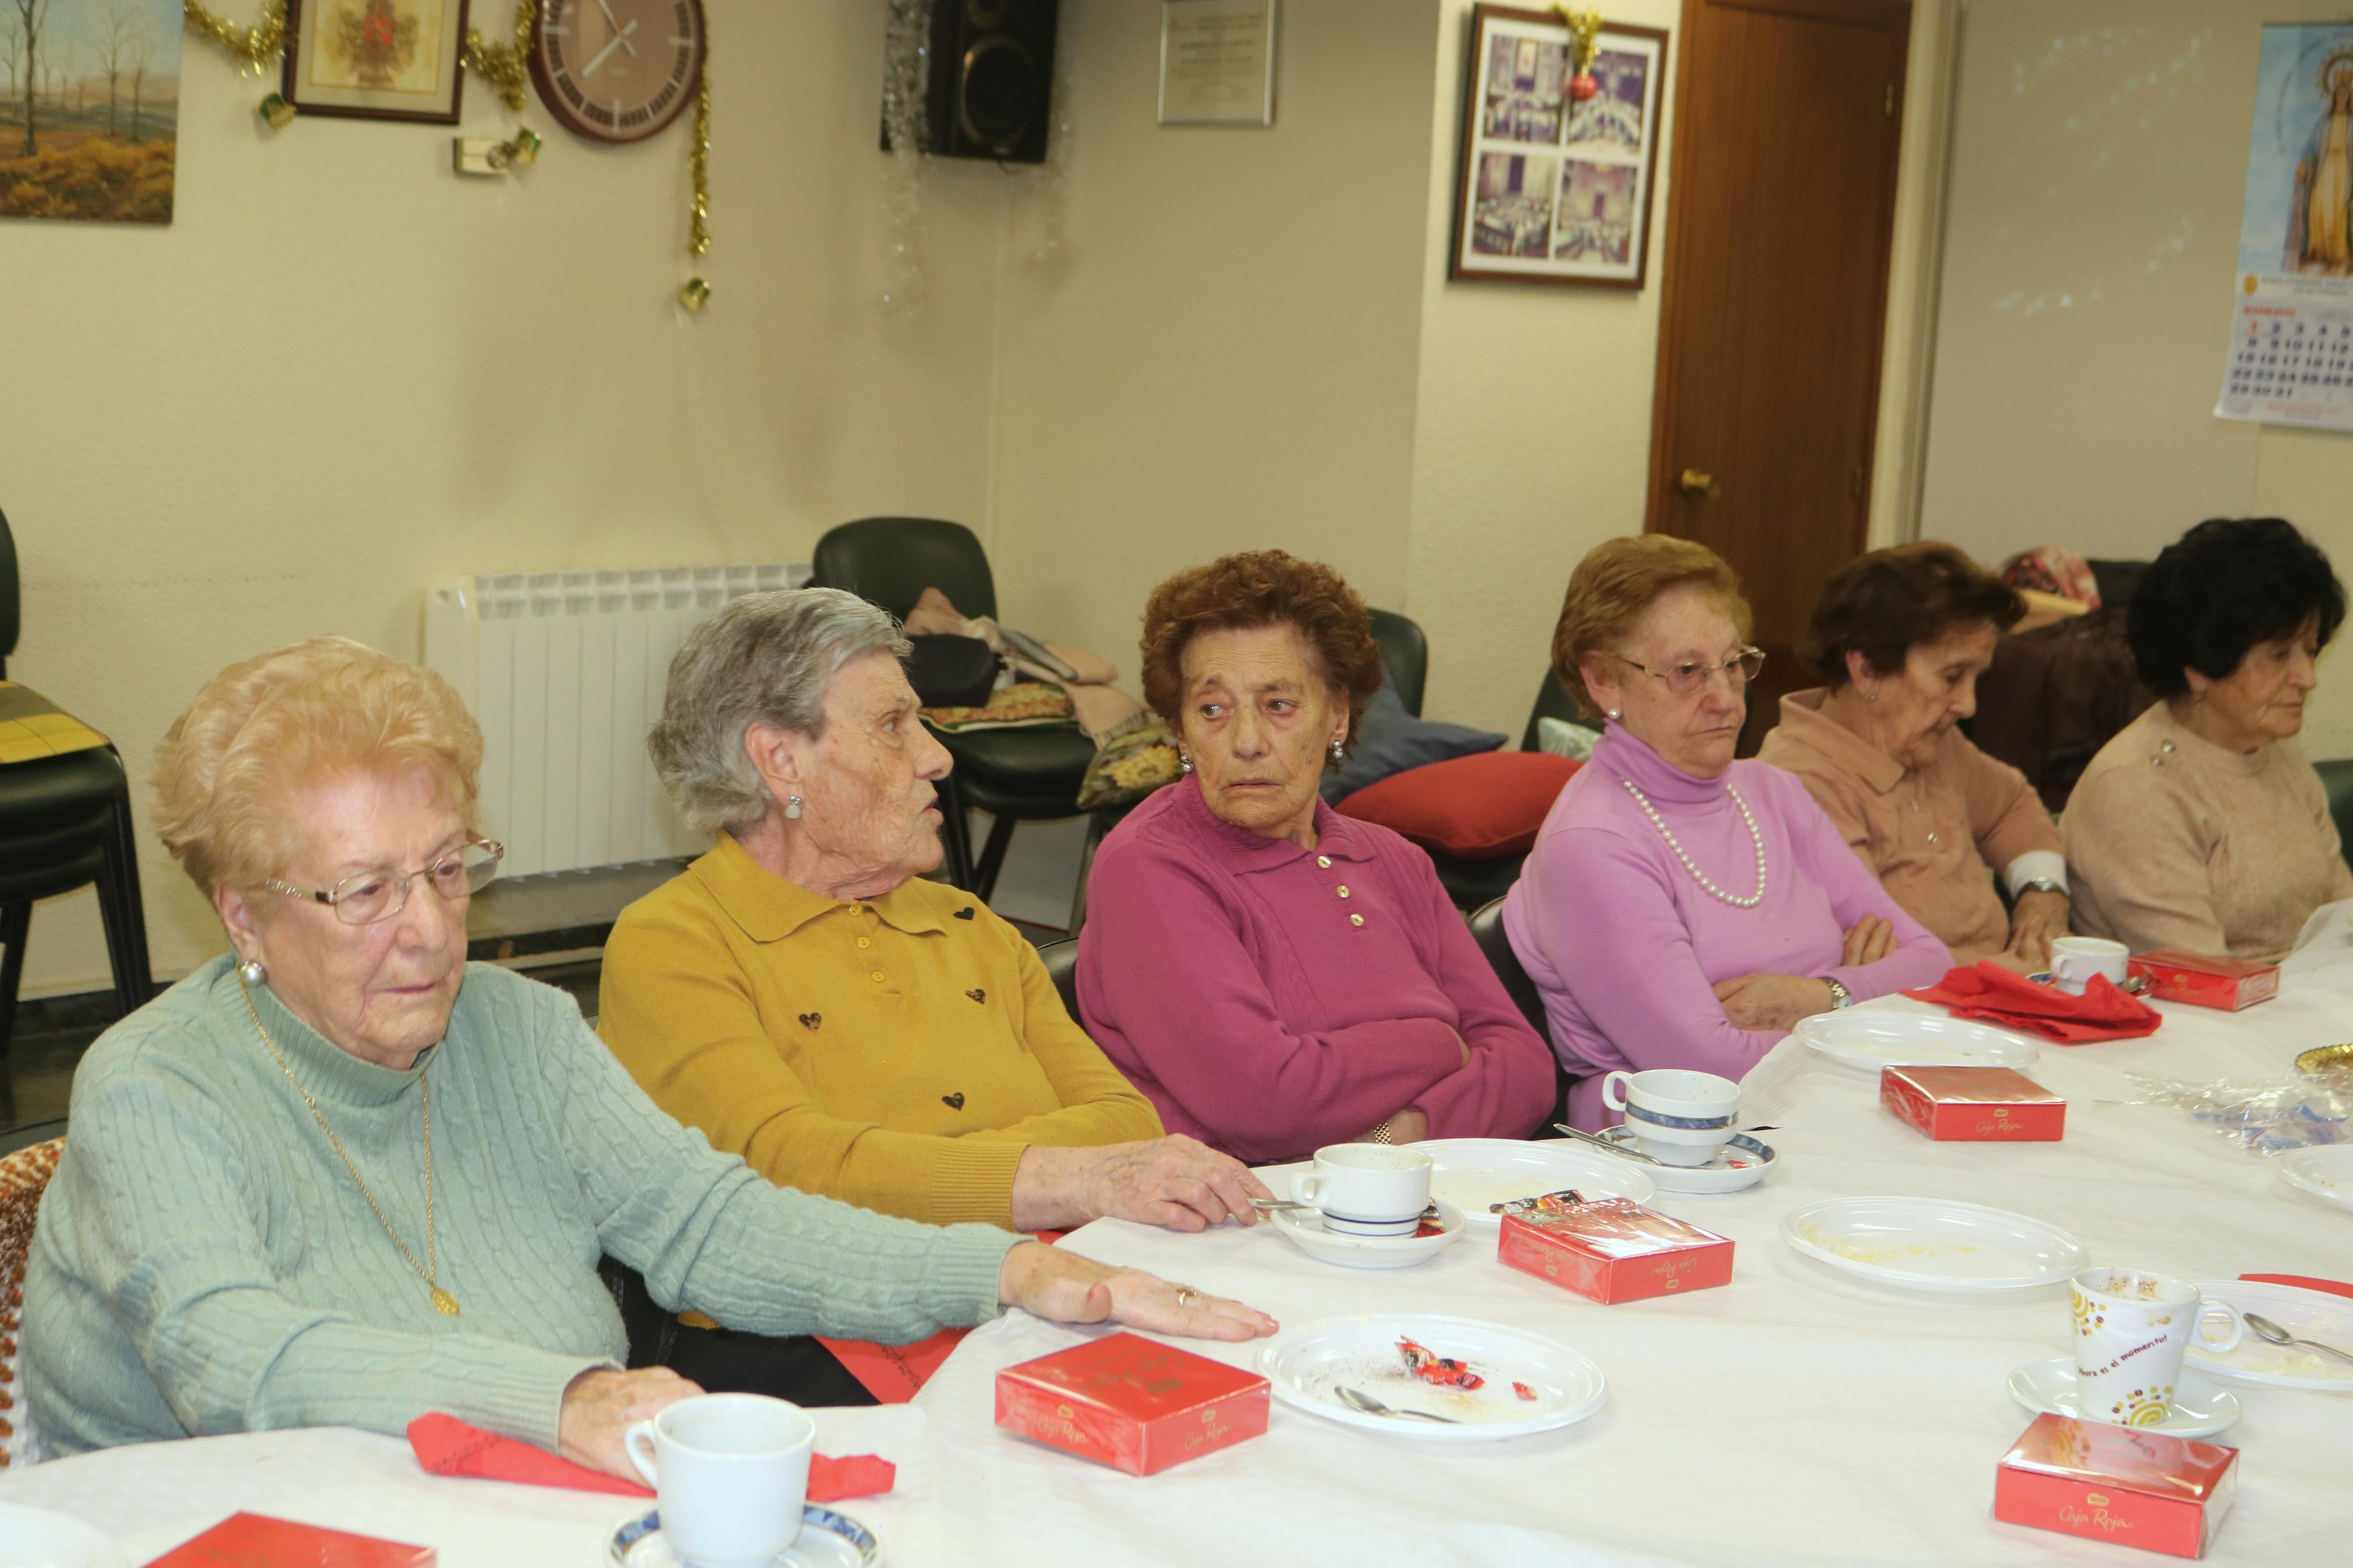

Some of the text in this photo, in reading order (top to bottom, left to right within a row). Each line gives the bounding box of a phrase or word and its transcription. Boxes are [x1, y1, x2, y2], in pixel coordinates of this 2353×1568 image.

[2111, 1359, 2119, 1367] el
[2059, 1505, 2132, 1531] Caja Roja
